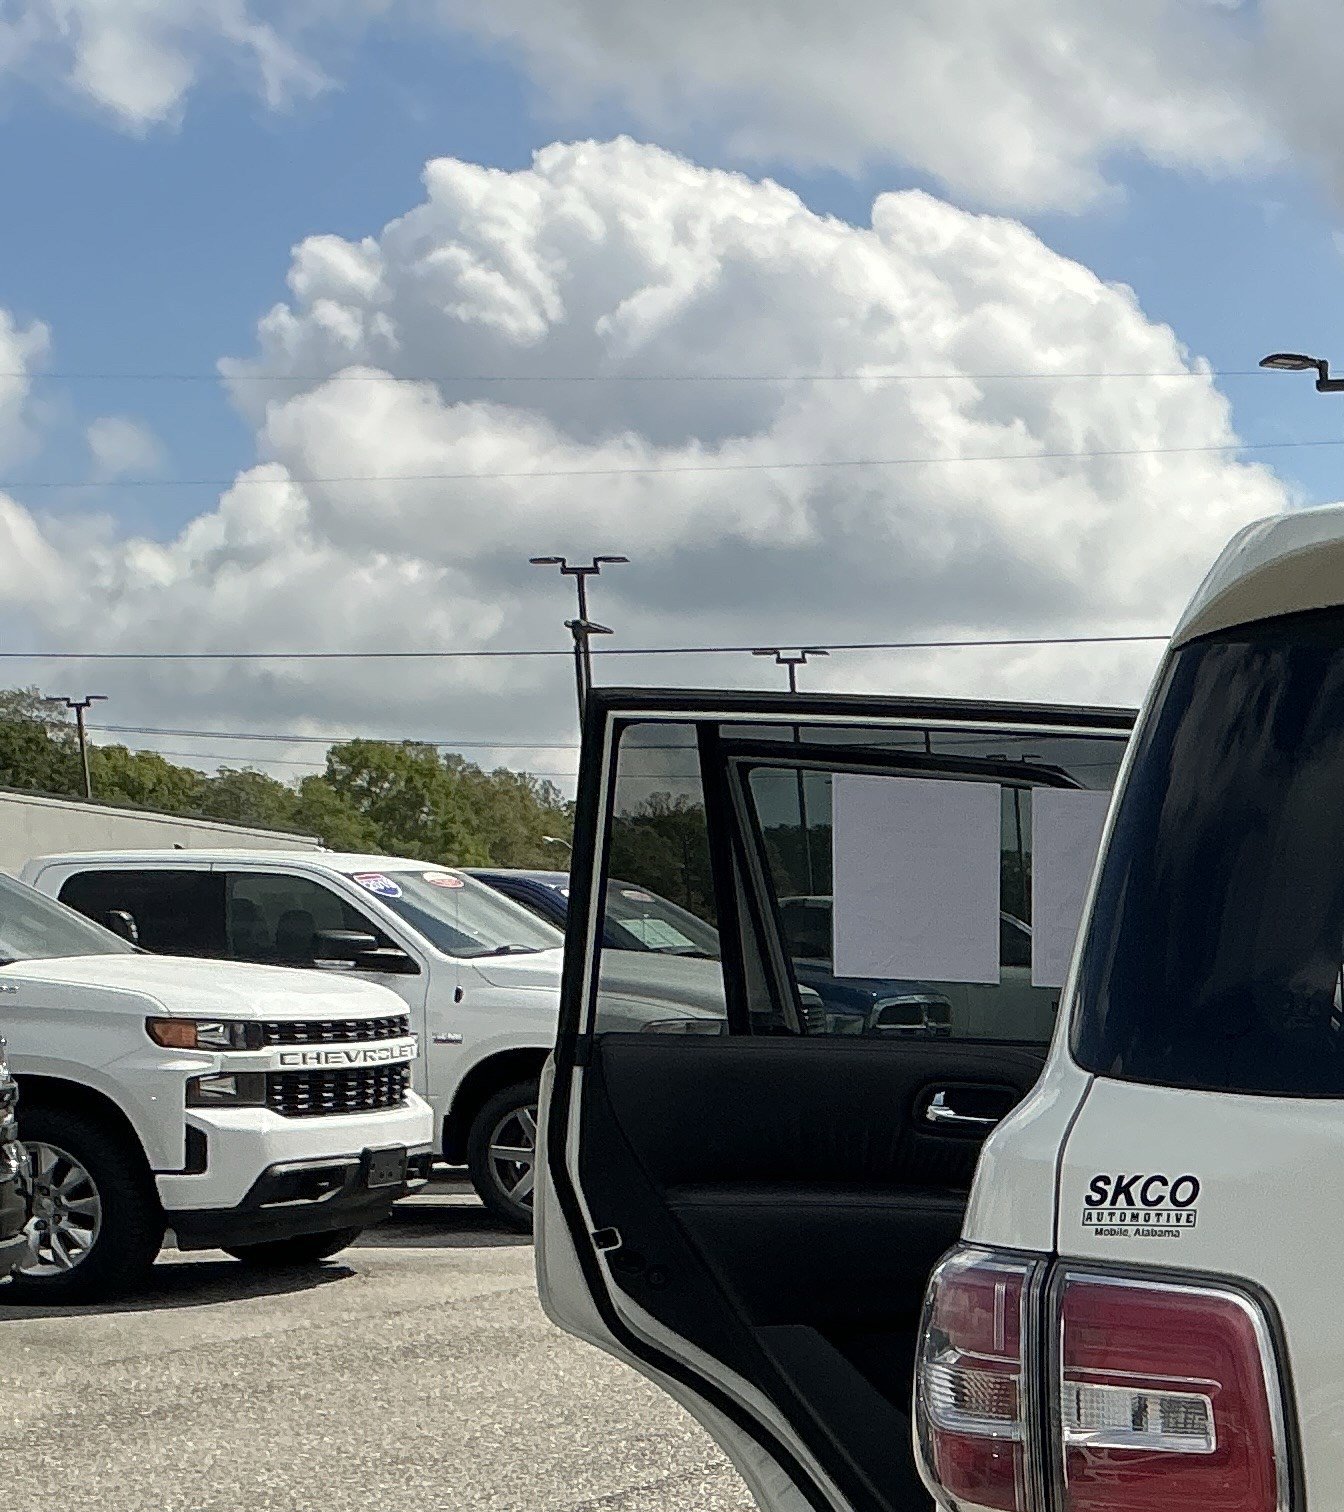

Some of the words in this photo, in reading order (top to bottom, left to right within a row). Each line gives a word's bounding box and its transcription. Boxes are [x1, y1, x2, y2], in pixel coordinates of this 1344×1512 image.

[280, 1044, 415, 1065] CHEVROLET
[1084, 1174, 1201, 1208] SKCO
[1085, 1211, 1194, 1224] AUTOMOTIVE
[1094, 1227, 1131, 1238] Mobile,
[1133, 1228, 1181, 1238] Alabama
